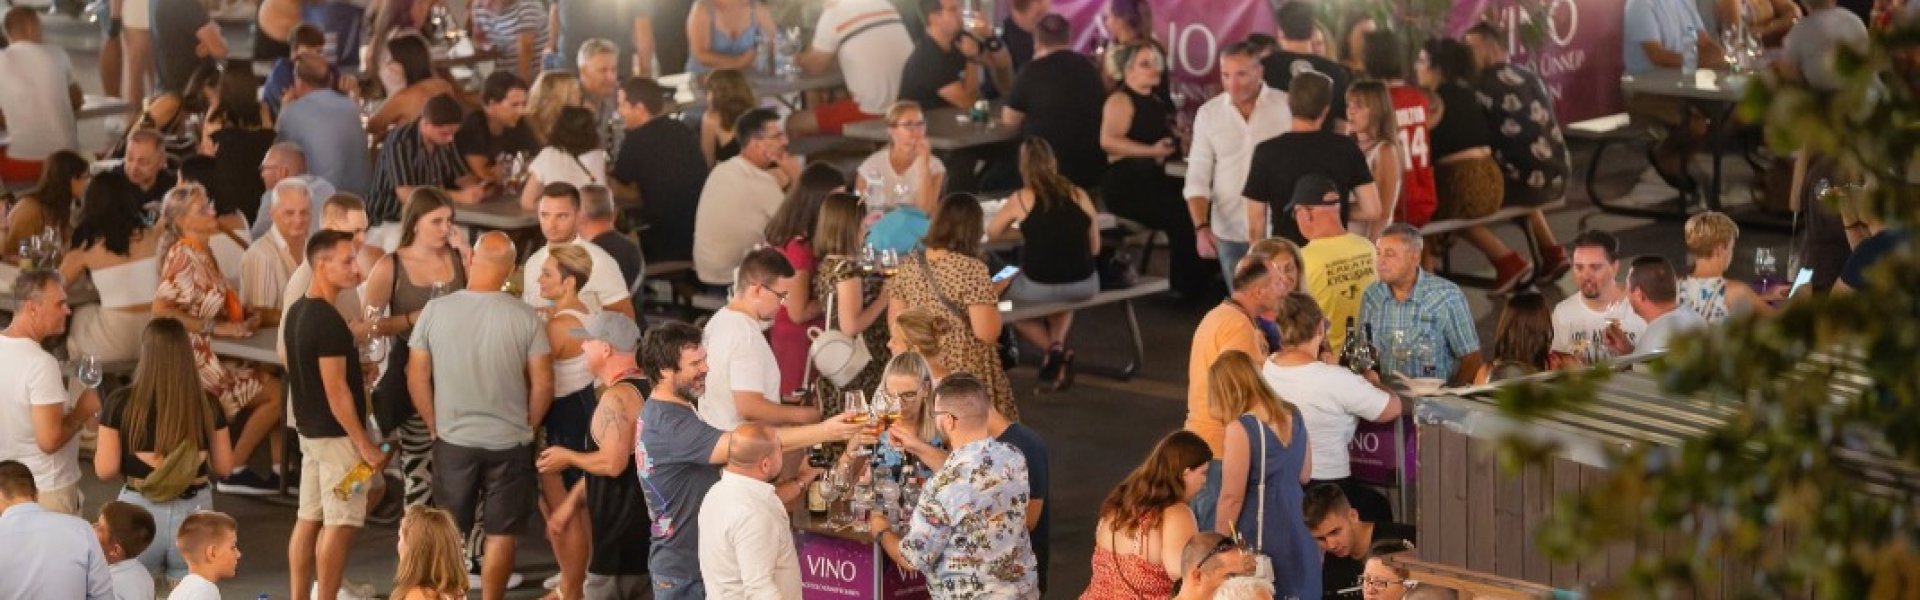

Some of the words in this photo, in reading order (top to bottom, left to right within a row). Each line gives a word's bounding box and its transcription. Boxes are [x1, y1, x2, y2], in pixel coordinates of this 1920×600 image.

[1397, 126, 1429, 170] 14
[1350, 432, 1379, 453] NO
[807, 554, 857, 582] VINO
